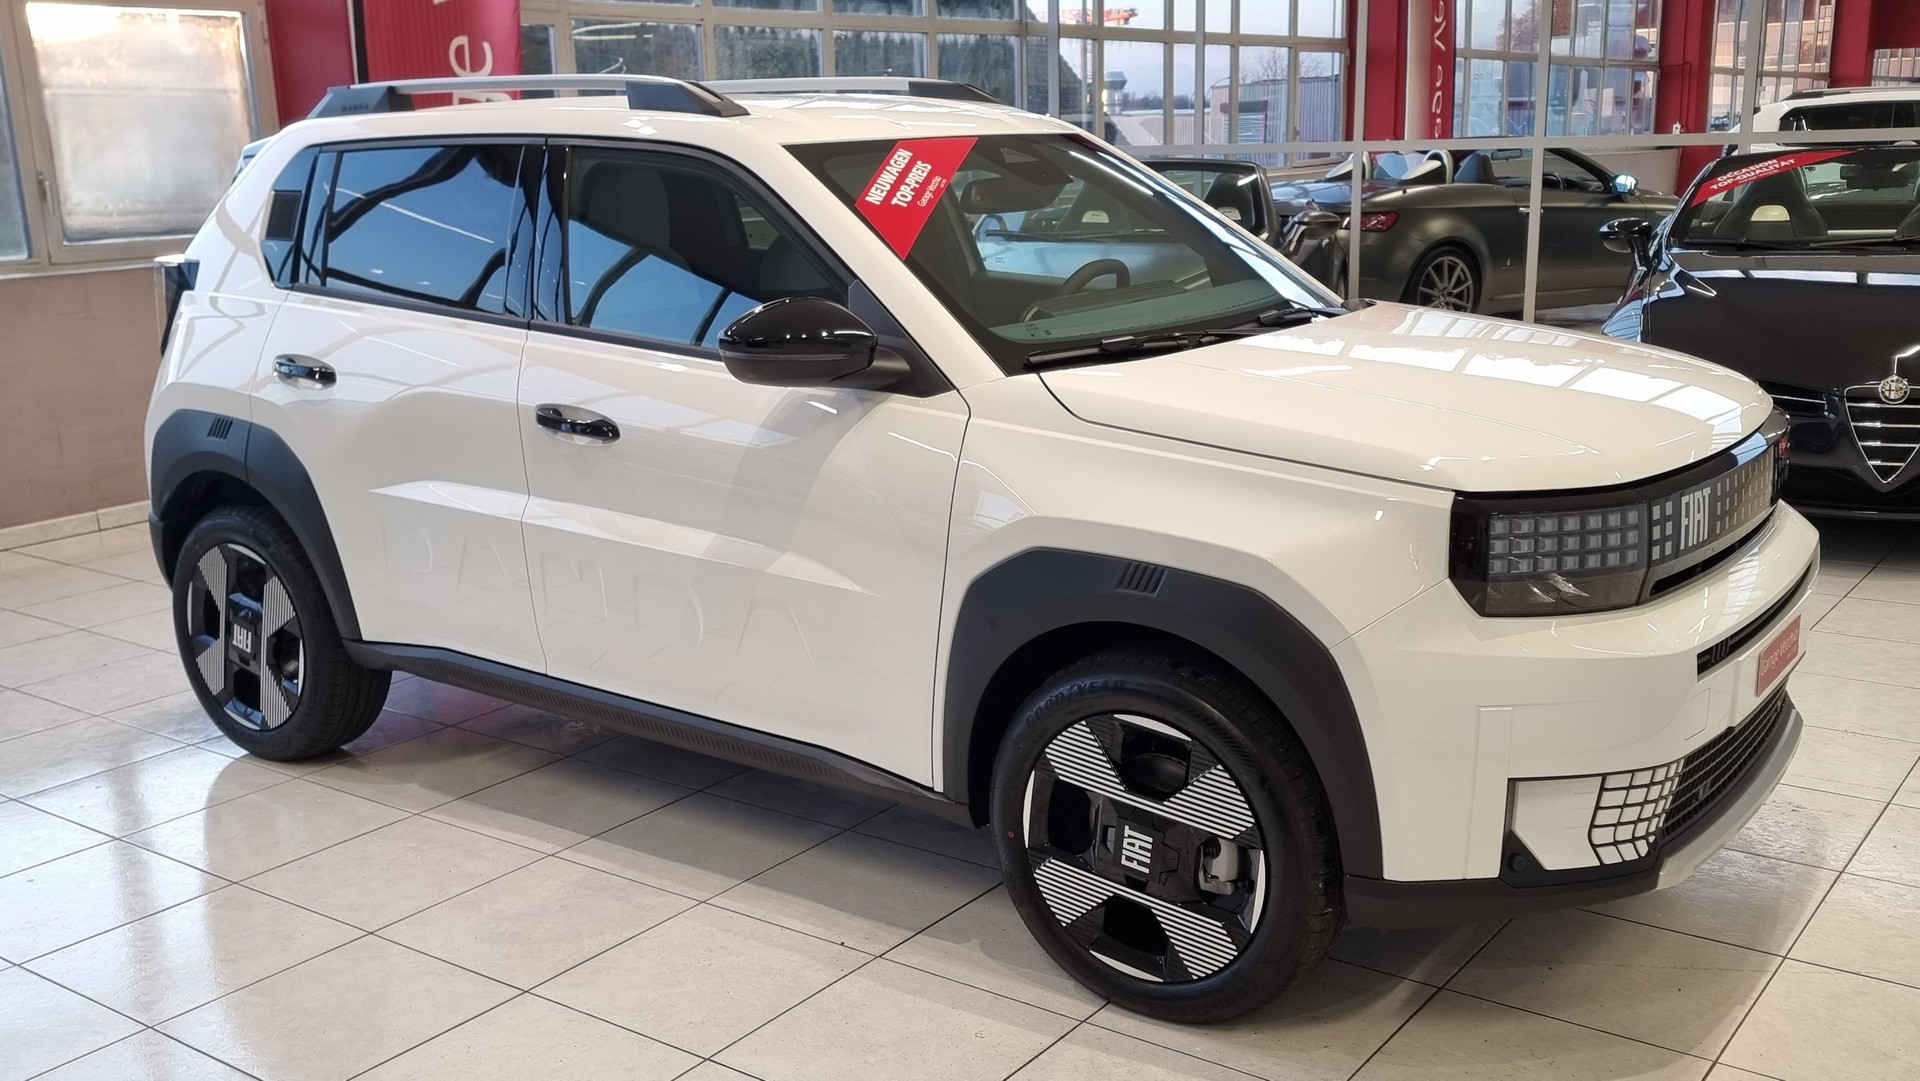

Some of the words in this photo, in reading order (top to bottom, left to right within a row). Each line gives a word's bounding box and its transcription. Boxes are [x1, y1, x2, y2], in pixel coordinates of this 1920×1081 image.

[865, 148, 913, 205] NEUWAGEN
[891, 160, 932, 208] TOP-PREIS
[1717, 158, 1778, 182] OCCASION
[1680, 486, 1711, 551] FIAT
[232, 623, 252, 654] FIAT
[1121, 824, 1153, 874] FIAT
